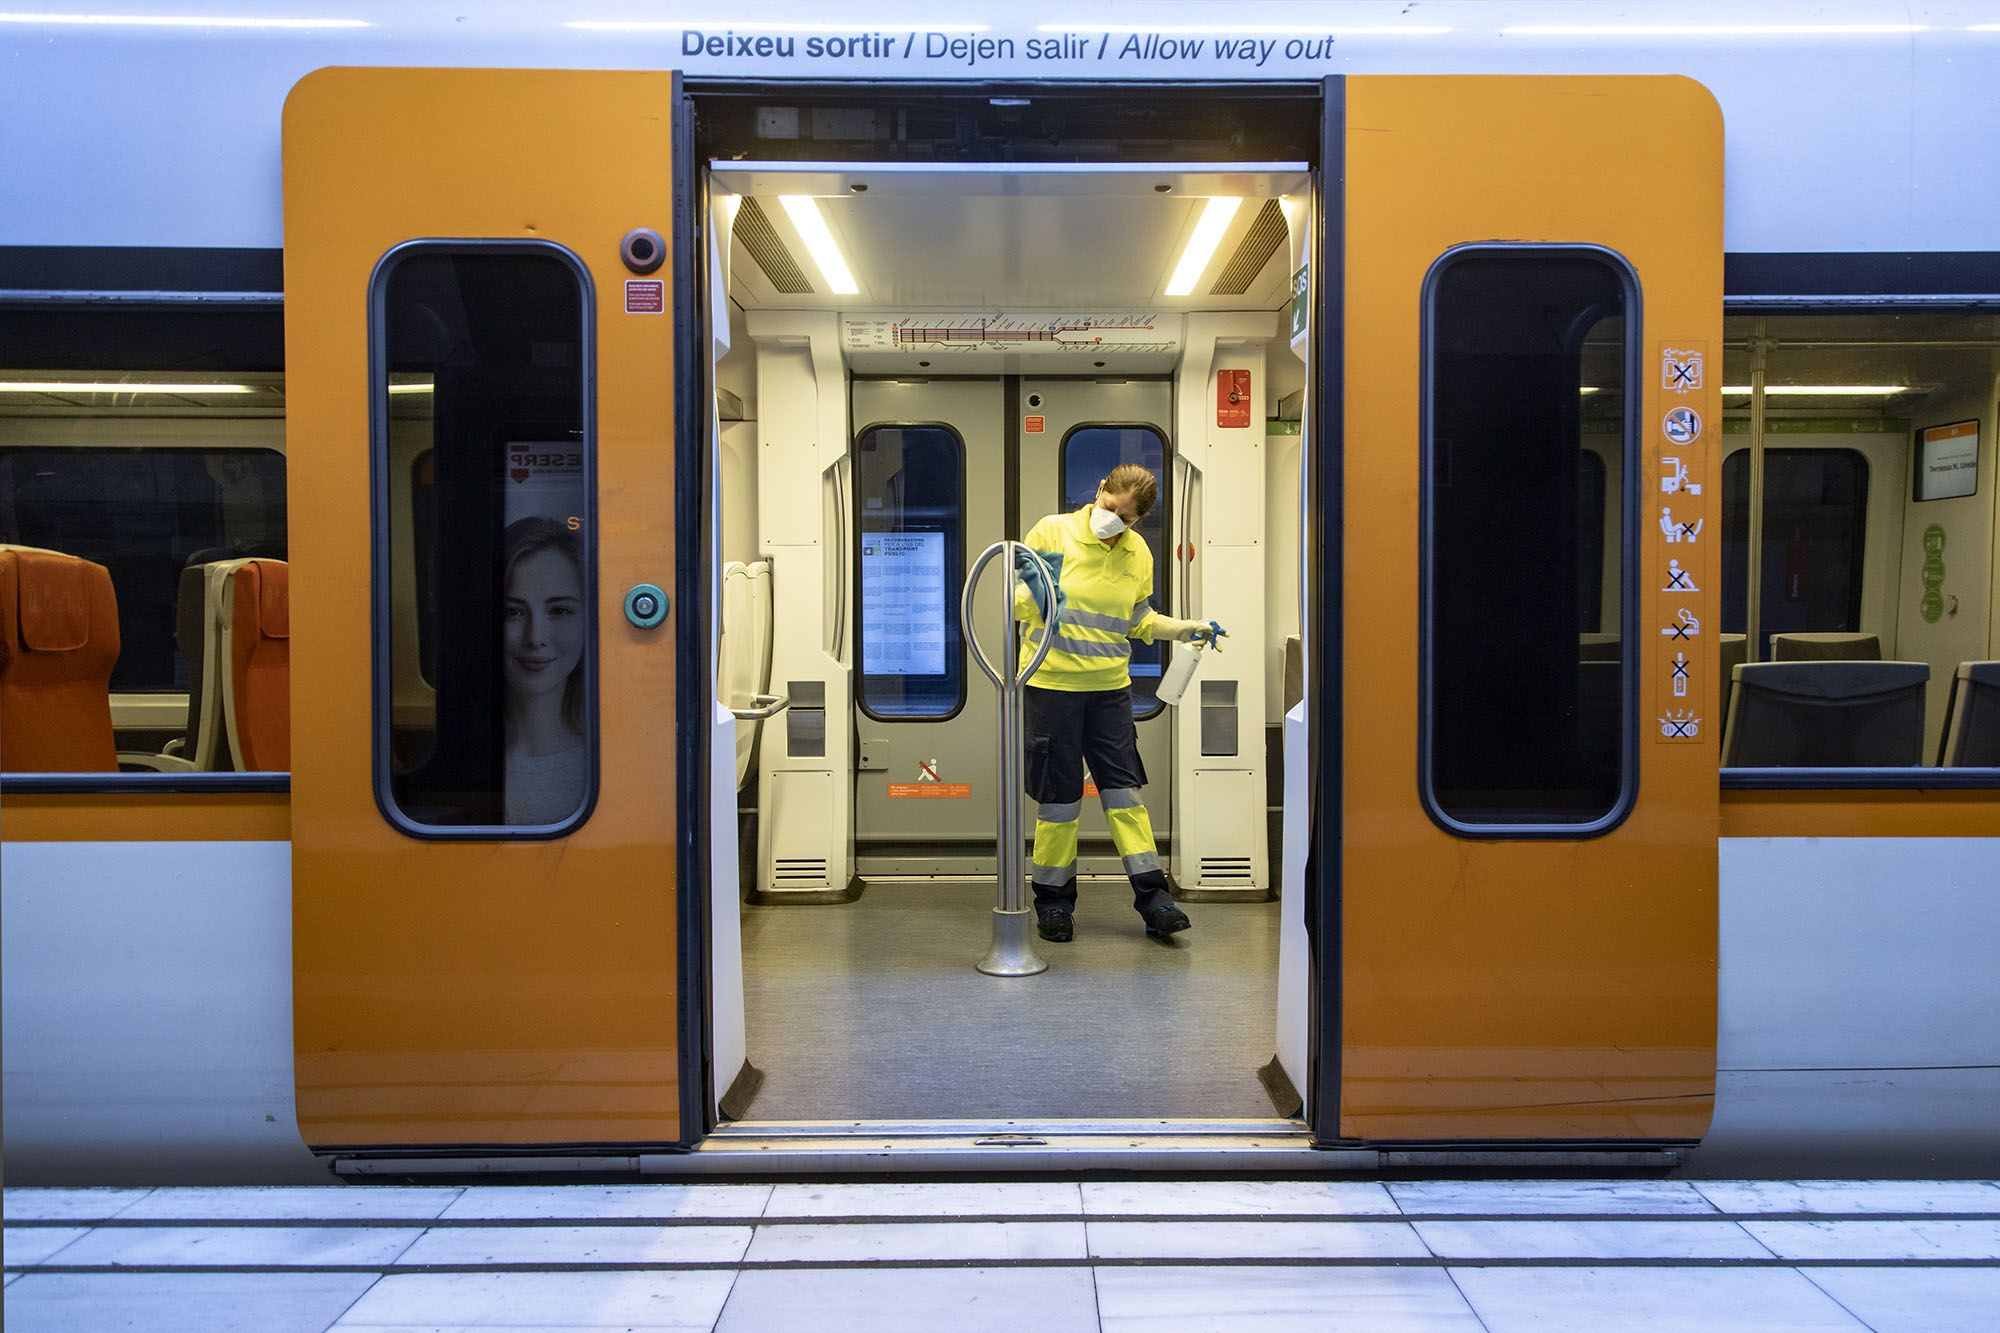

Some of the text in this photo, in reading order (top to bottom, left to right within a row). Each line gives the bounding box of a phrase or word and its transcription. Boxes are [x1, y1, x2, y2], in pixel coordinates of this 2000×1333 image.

[681, 29, 1335, 67] Deixeu sortir / Dejen salir / Allow way out
[1293, 271, 1307, 299] SOS
